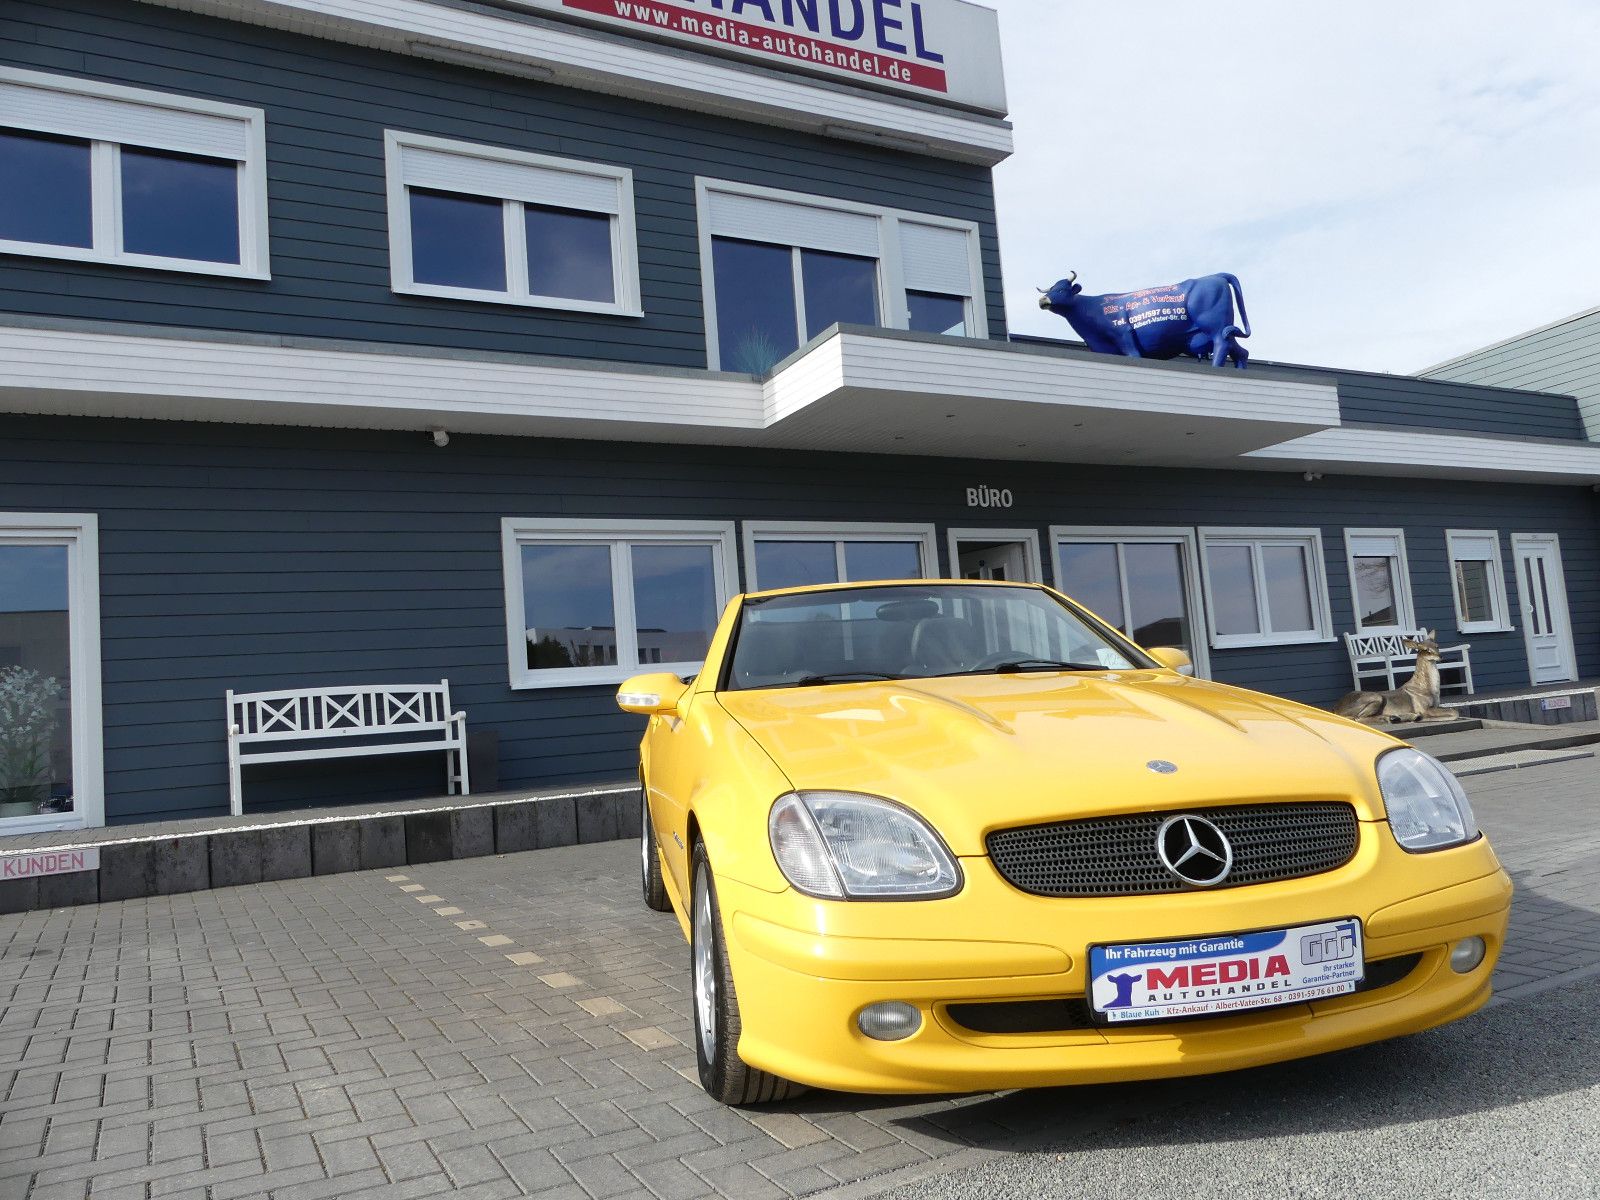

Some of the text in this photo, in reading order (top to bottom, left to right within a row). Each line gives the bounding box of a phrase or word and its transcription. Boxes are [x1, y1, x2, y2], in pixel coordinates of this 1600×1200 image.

[615, 1, 911, 81] www.media-autohandel.de
[1173, 307, 1186, 315] 100
[966, 484, 1013, 507] BÜRO
[3, 851, 84, 878] KUNDEN
[1105, 939, 1244, 959] Ihr Fahrzeug mit Garantie
[1147, 955, 1290, 990] MEDIA
[1302, 969, 1355, 984] Garantie-Partner
[1323, 961, 1355, 973] Ihr starker
[1120, 1011, 1142, 1019] Blaue
[1144, 1009, 1160, 1017] Kuh
[1166, 1004, 1209, 1015] Kfz-Ankauf
[1215, 996, 1272, 1010] Albert-Vater-Str.
[1273, 995, 1282, 1003] 68
[1288, 990, 1315, 1001] 0391-59
[1317, 988, 1325, 996] 76
[1327, 986, 1335, 994] 61
[1336, 984, 1345, 992] 00
[1148, 980, 1292, 1002] AUTOHANDEL
